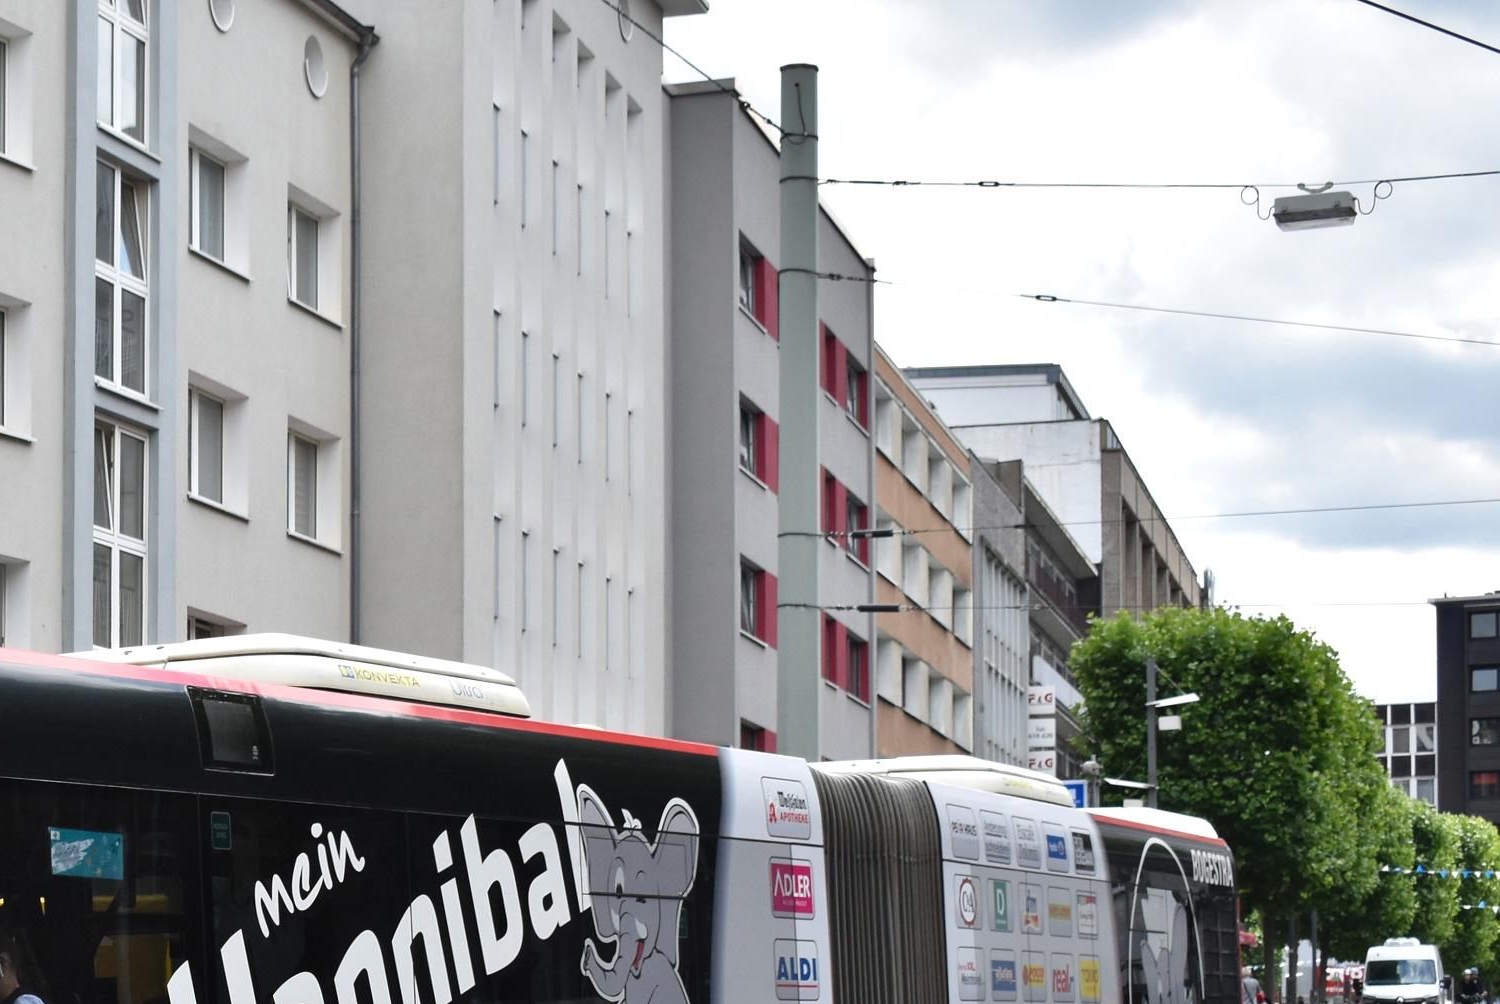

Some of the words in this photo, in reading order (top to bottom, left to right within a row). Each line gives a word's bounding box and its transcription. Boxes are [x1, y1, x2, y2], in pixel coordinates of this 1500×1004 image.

[354, 667, 420, 688] KONVEKTA
[780, 812, 809, 824] APOTHEKE
[254, 822, 366, 938] mein
[1190, 849, 1234, 887] BOGESTRA
[774, 869, 811, 898] ADLER
[777, 957, 817, 981] ALDI
